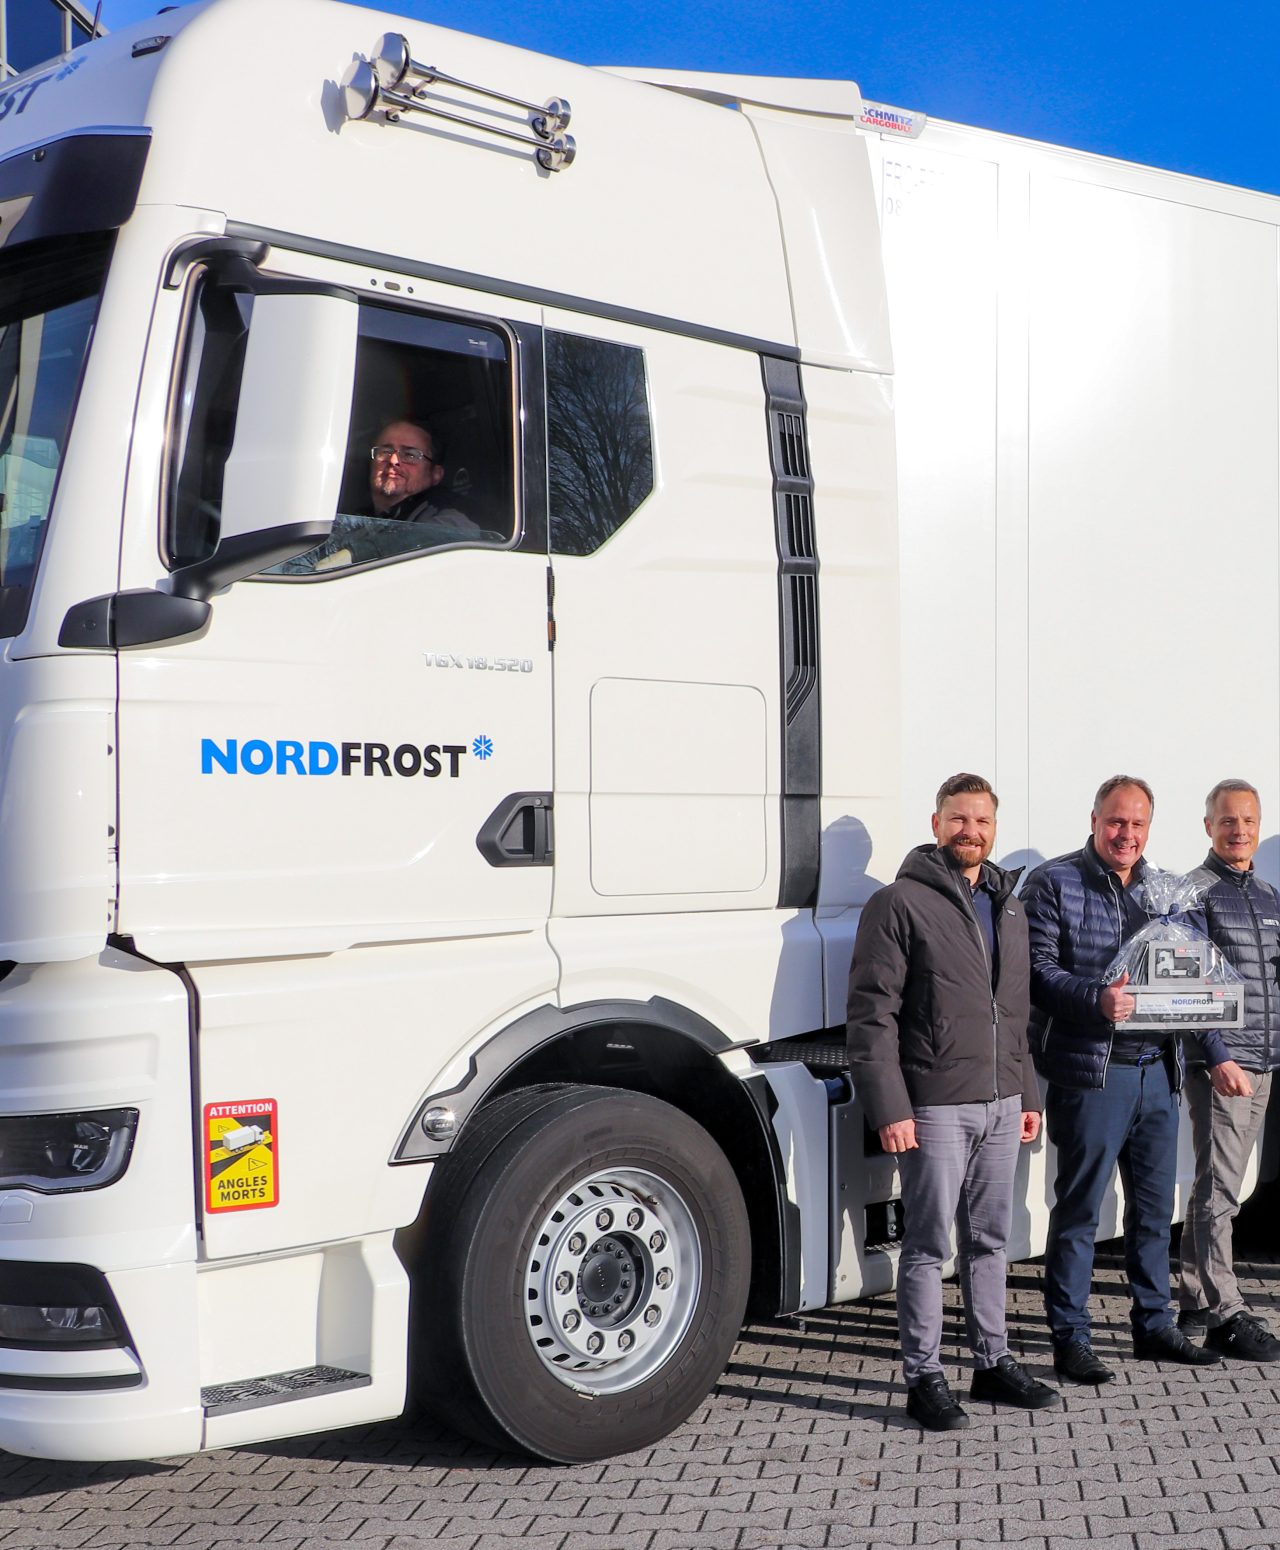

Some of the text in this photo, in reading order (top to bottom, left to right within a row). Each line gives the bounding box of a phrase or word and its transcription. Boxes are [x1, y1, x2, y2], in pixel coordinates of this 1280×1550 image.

[860, 115, 912, 133] CARGOBULL
[423, 652, 533, 673] TGX 18.520
[201, 738, 467, 778] NORDFROST
[209, 1102, 273, 1117] ATTENTION
[217, 1175, 268, 1190] ANGLES
[220, 1187, 266, 1202] MORTS
